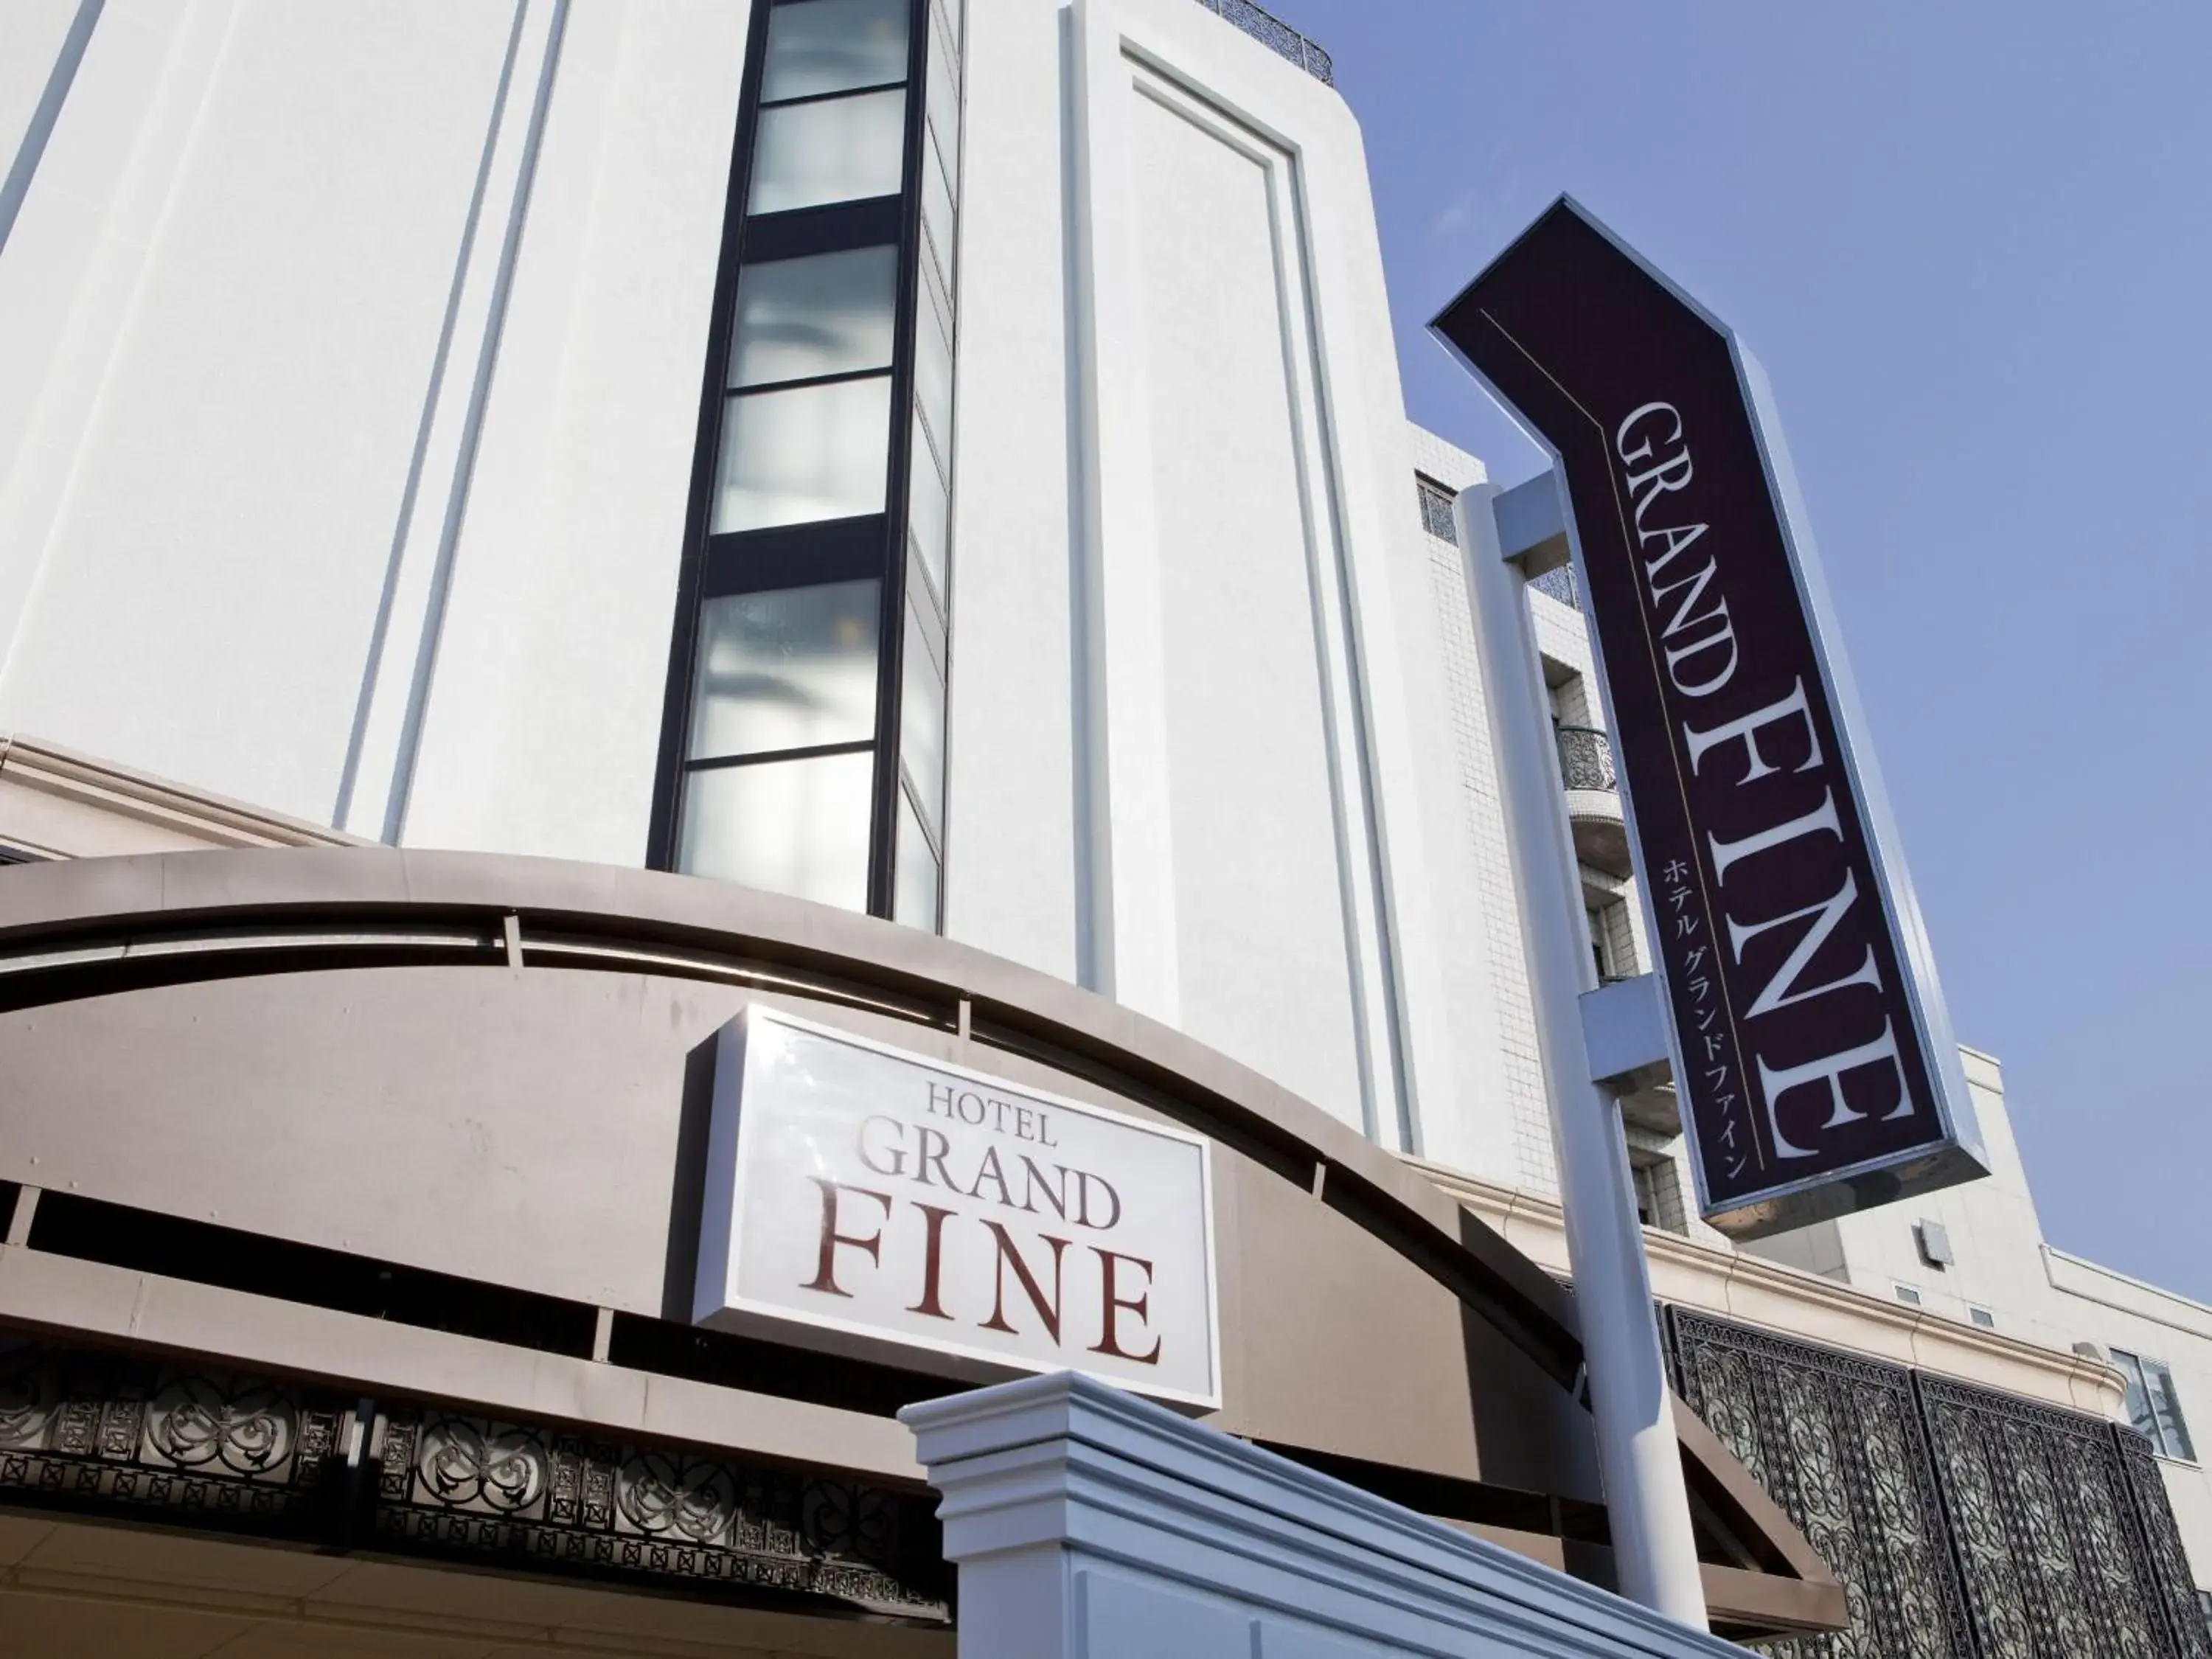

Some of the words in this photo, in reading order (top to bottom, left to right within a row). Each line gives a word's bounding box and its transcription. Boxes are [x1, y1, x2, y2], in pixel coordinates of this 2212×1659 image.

[1616, 401, 1738, 697] GRAND
[1683, 675, 1915, 1159] FINE
[857, 1116, 1121, 1230] GRAND
[926, 1081, 1057, 1148] HOTEL
[799, 1176, 1162, 1365] FINE
